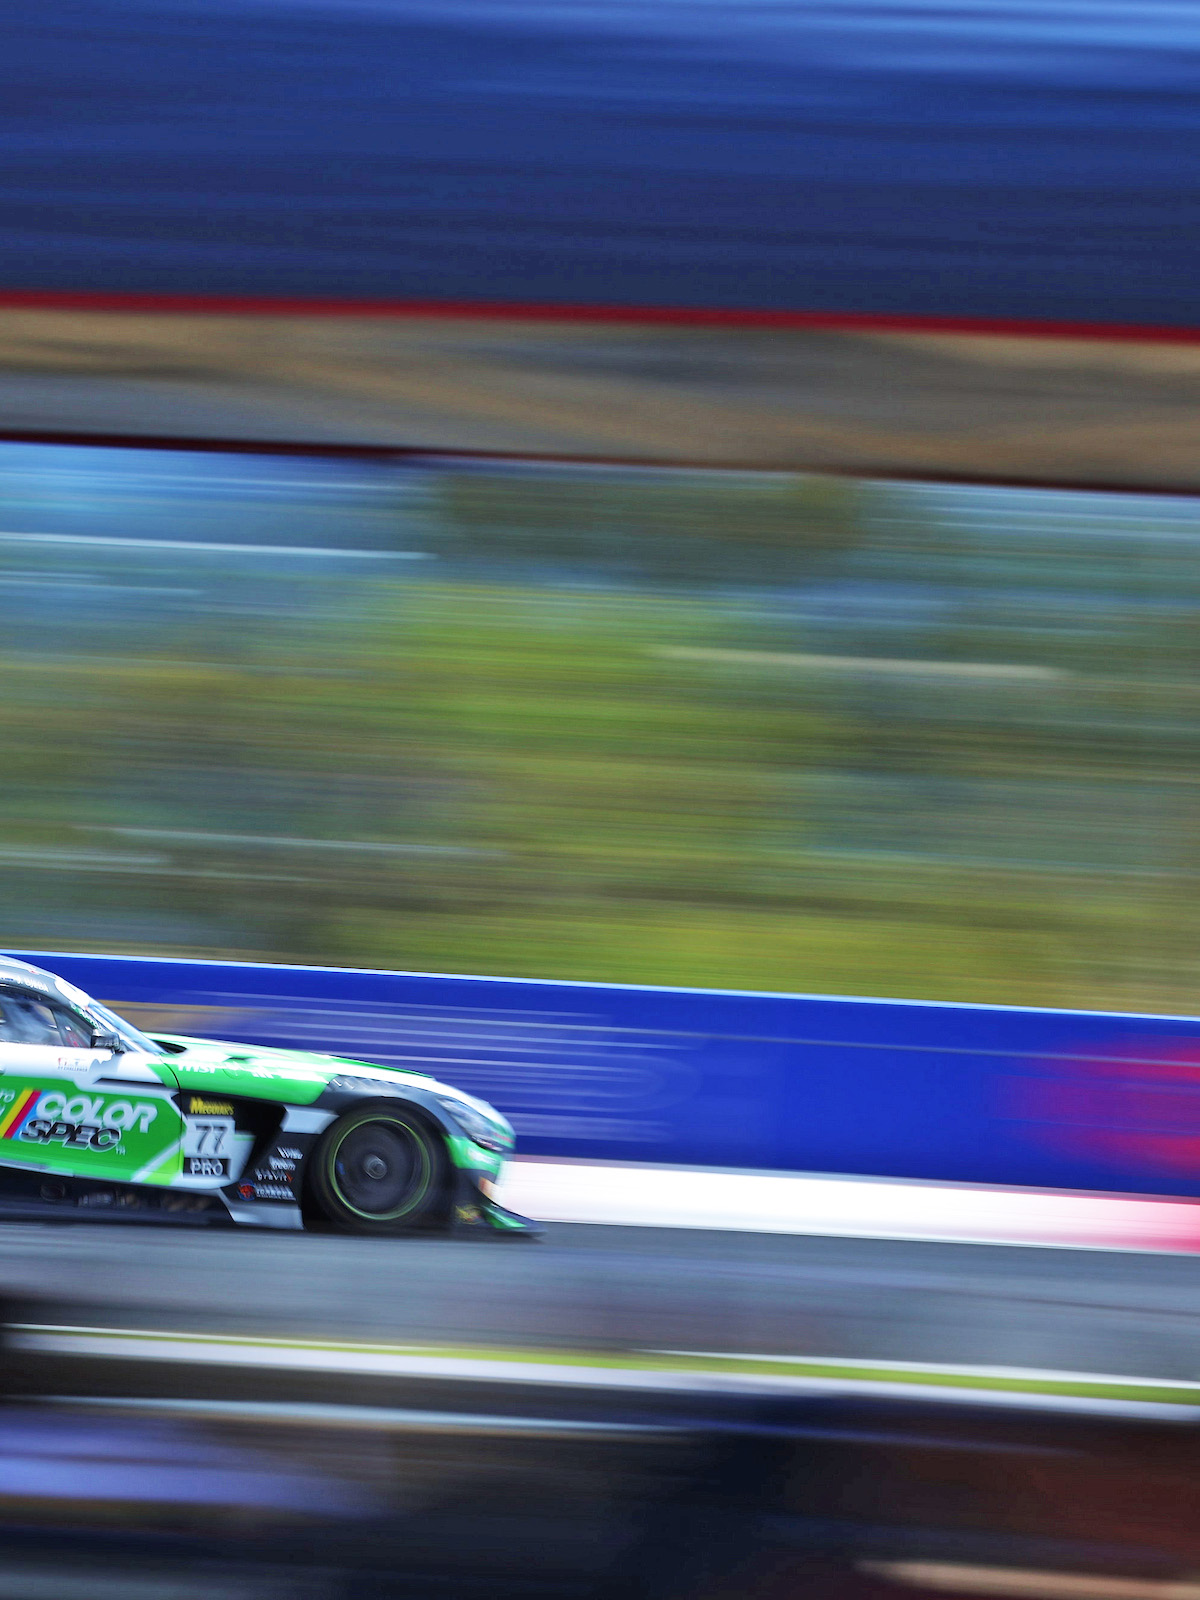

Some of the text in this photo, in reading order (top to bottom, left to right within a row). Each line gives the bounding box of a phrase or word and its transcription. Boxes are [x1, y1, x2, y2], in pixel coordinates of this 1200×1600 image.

[36, 1089, 158, 1133] COLOR
[18, 1118, 122, 1153] SPEC
[194, 1123, 228, 1154] 77
[189, 1159, 224, 1177] PRO
